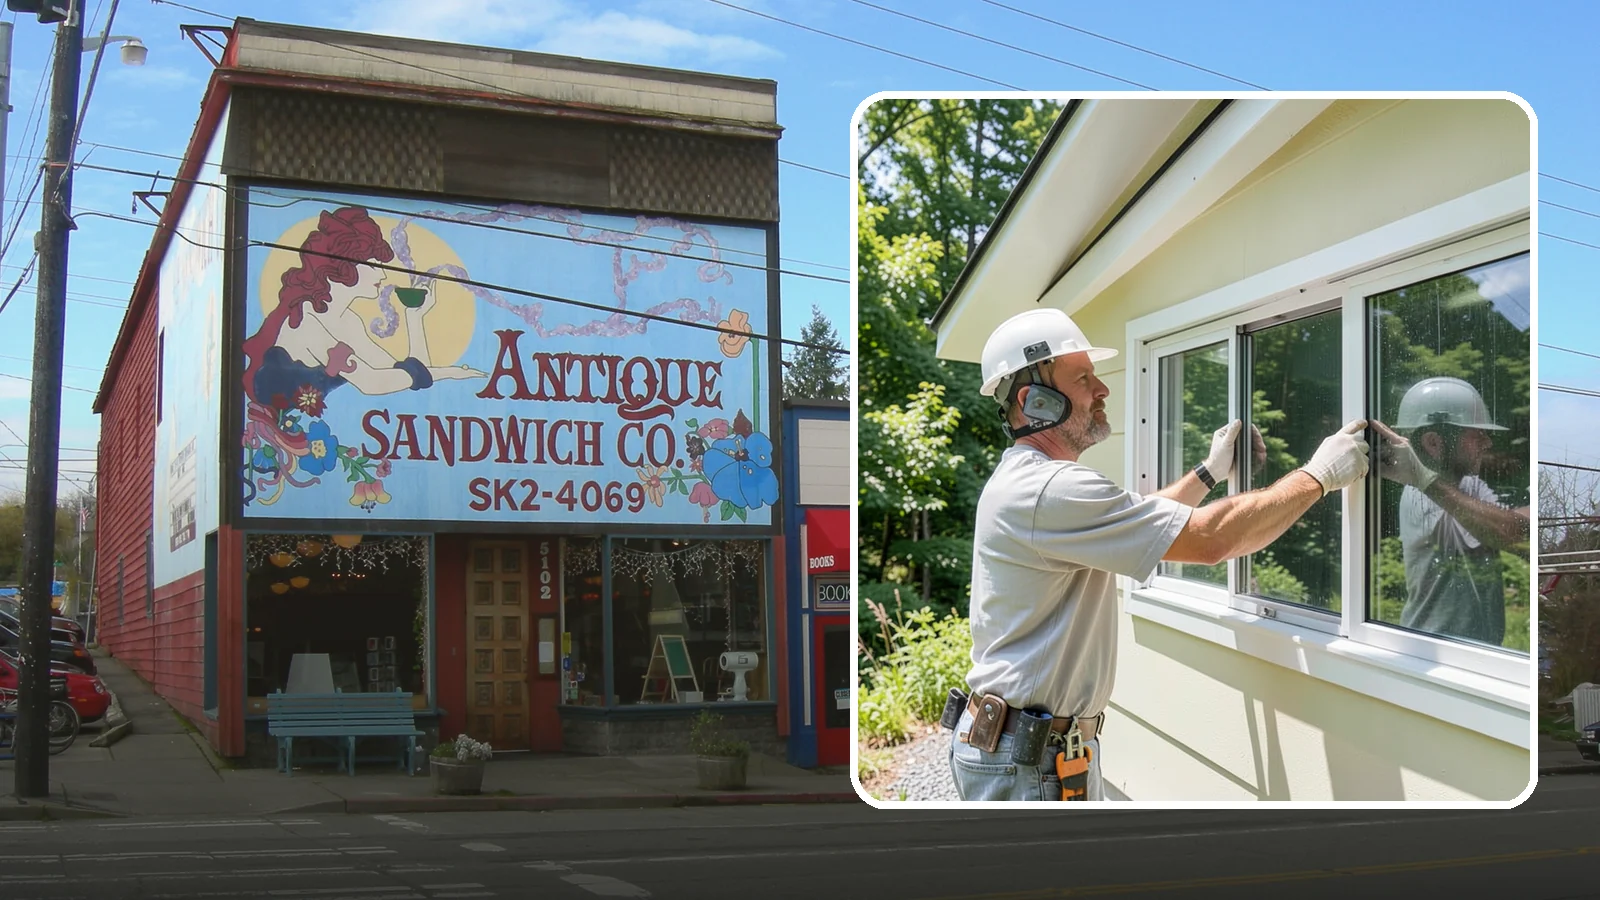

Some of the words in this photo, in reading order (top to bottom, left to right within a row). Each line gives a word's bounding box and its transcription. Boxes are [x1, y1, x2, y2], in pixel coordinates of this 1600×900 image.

[476, 329, 724, 421] ANTIQUE
[360, 409, 605, 468] SANDWICH
[616, 423, 685, 469] CO.
[468, 477, 646, 513] SK2-4069
[540, 542, 551, 599] 5102
[809, 555, 835, 569] BOOKS
